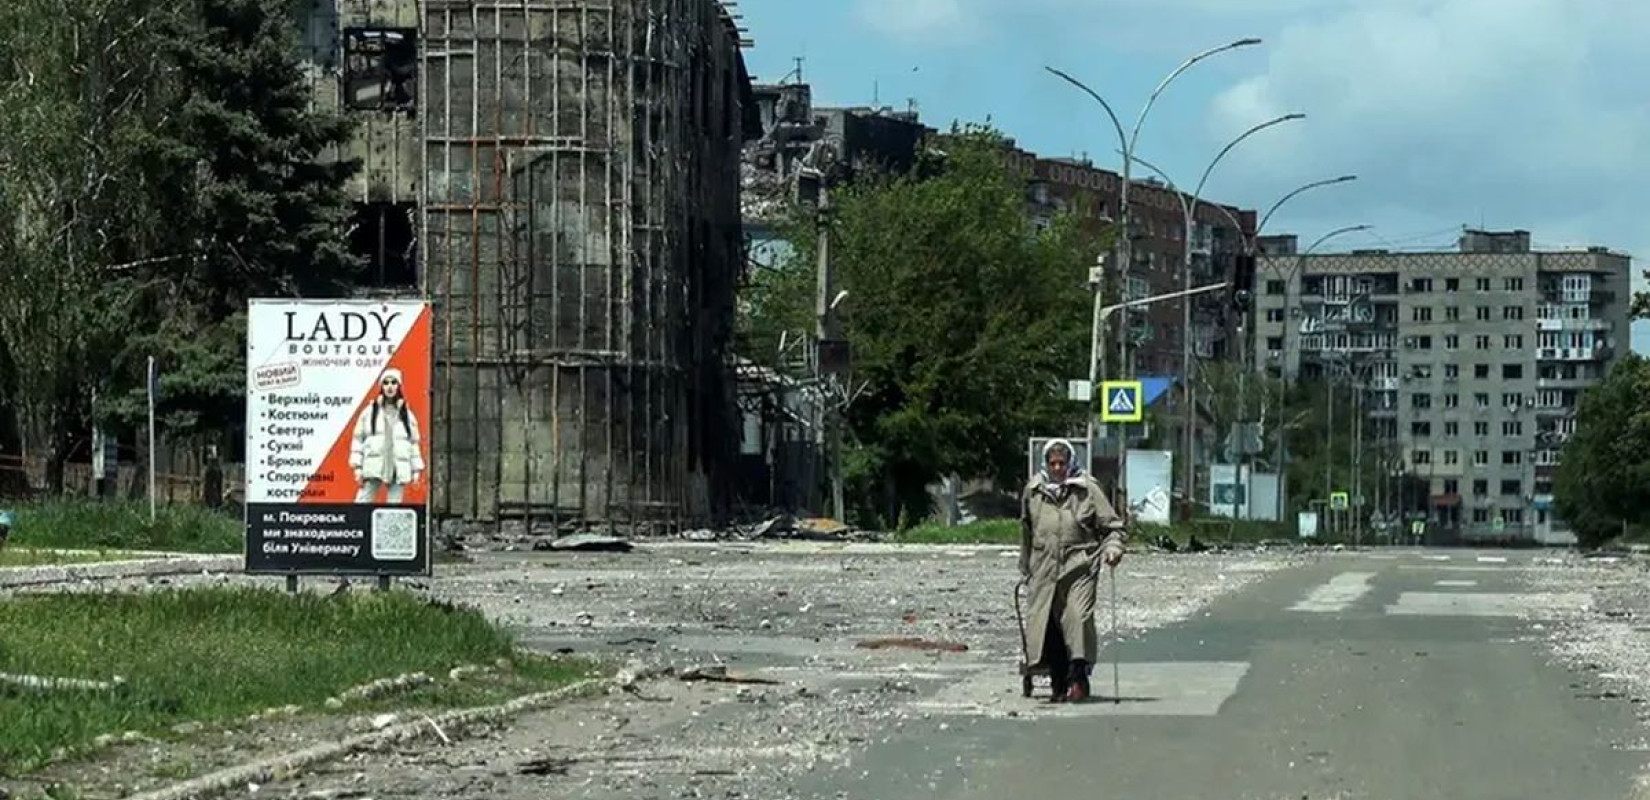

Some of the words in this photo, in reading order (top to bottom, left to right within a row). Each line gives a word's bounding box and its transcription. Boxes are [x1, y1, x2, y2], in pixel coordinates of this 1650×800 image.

[284, 307, 402, 341] LADY
[289, 344, 396, 355] BOUTIQUE
[268, 393, 320, 406] Верхній
[323, 396, 352, 406] одяг
[268, 409, 328, 420] Костюми
[267, 424, 314, 437] Светри
[267, 439, 303, 453] Сукні
[267, 455, 312, 467] Брюки
[267, 471, 334, 484] Спортивні
[267, 488, 326, 498] костюми
[263, 514, 275, 522] м.
[279, 512, 346, 524] Покровськ
[263, 529, 281, 538] ми
[283, 529, 364, 540] знаходимося
[262, 541, 288, 553] біля
[291, 541, 361, 557] Універмагу
